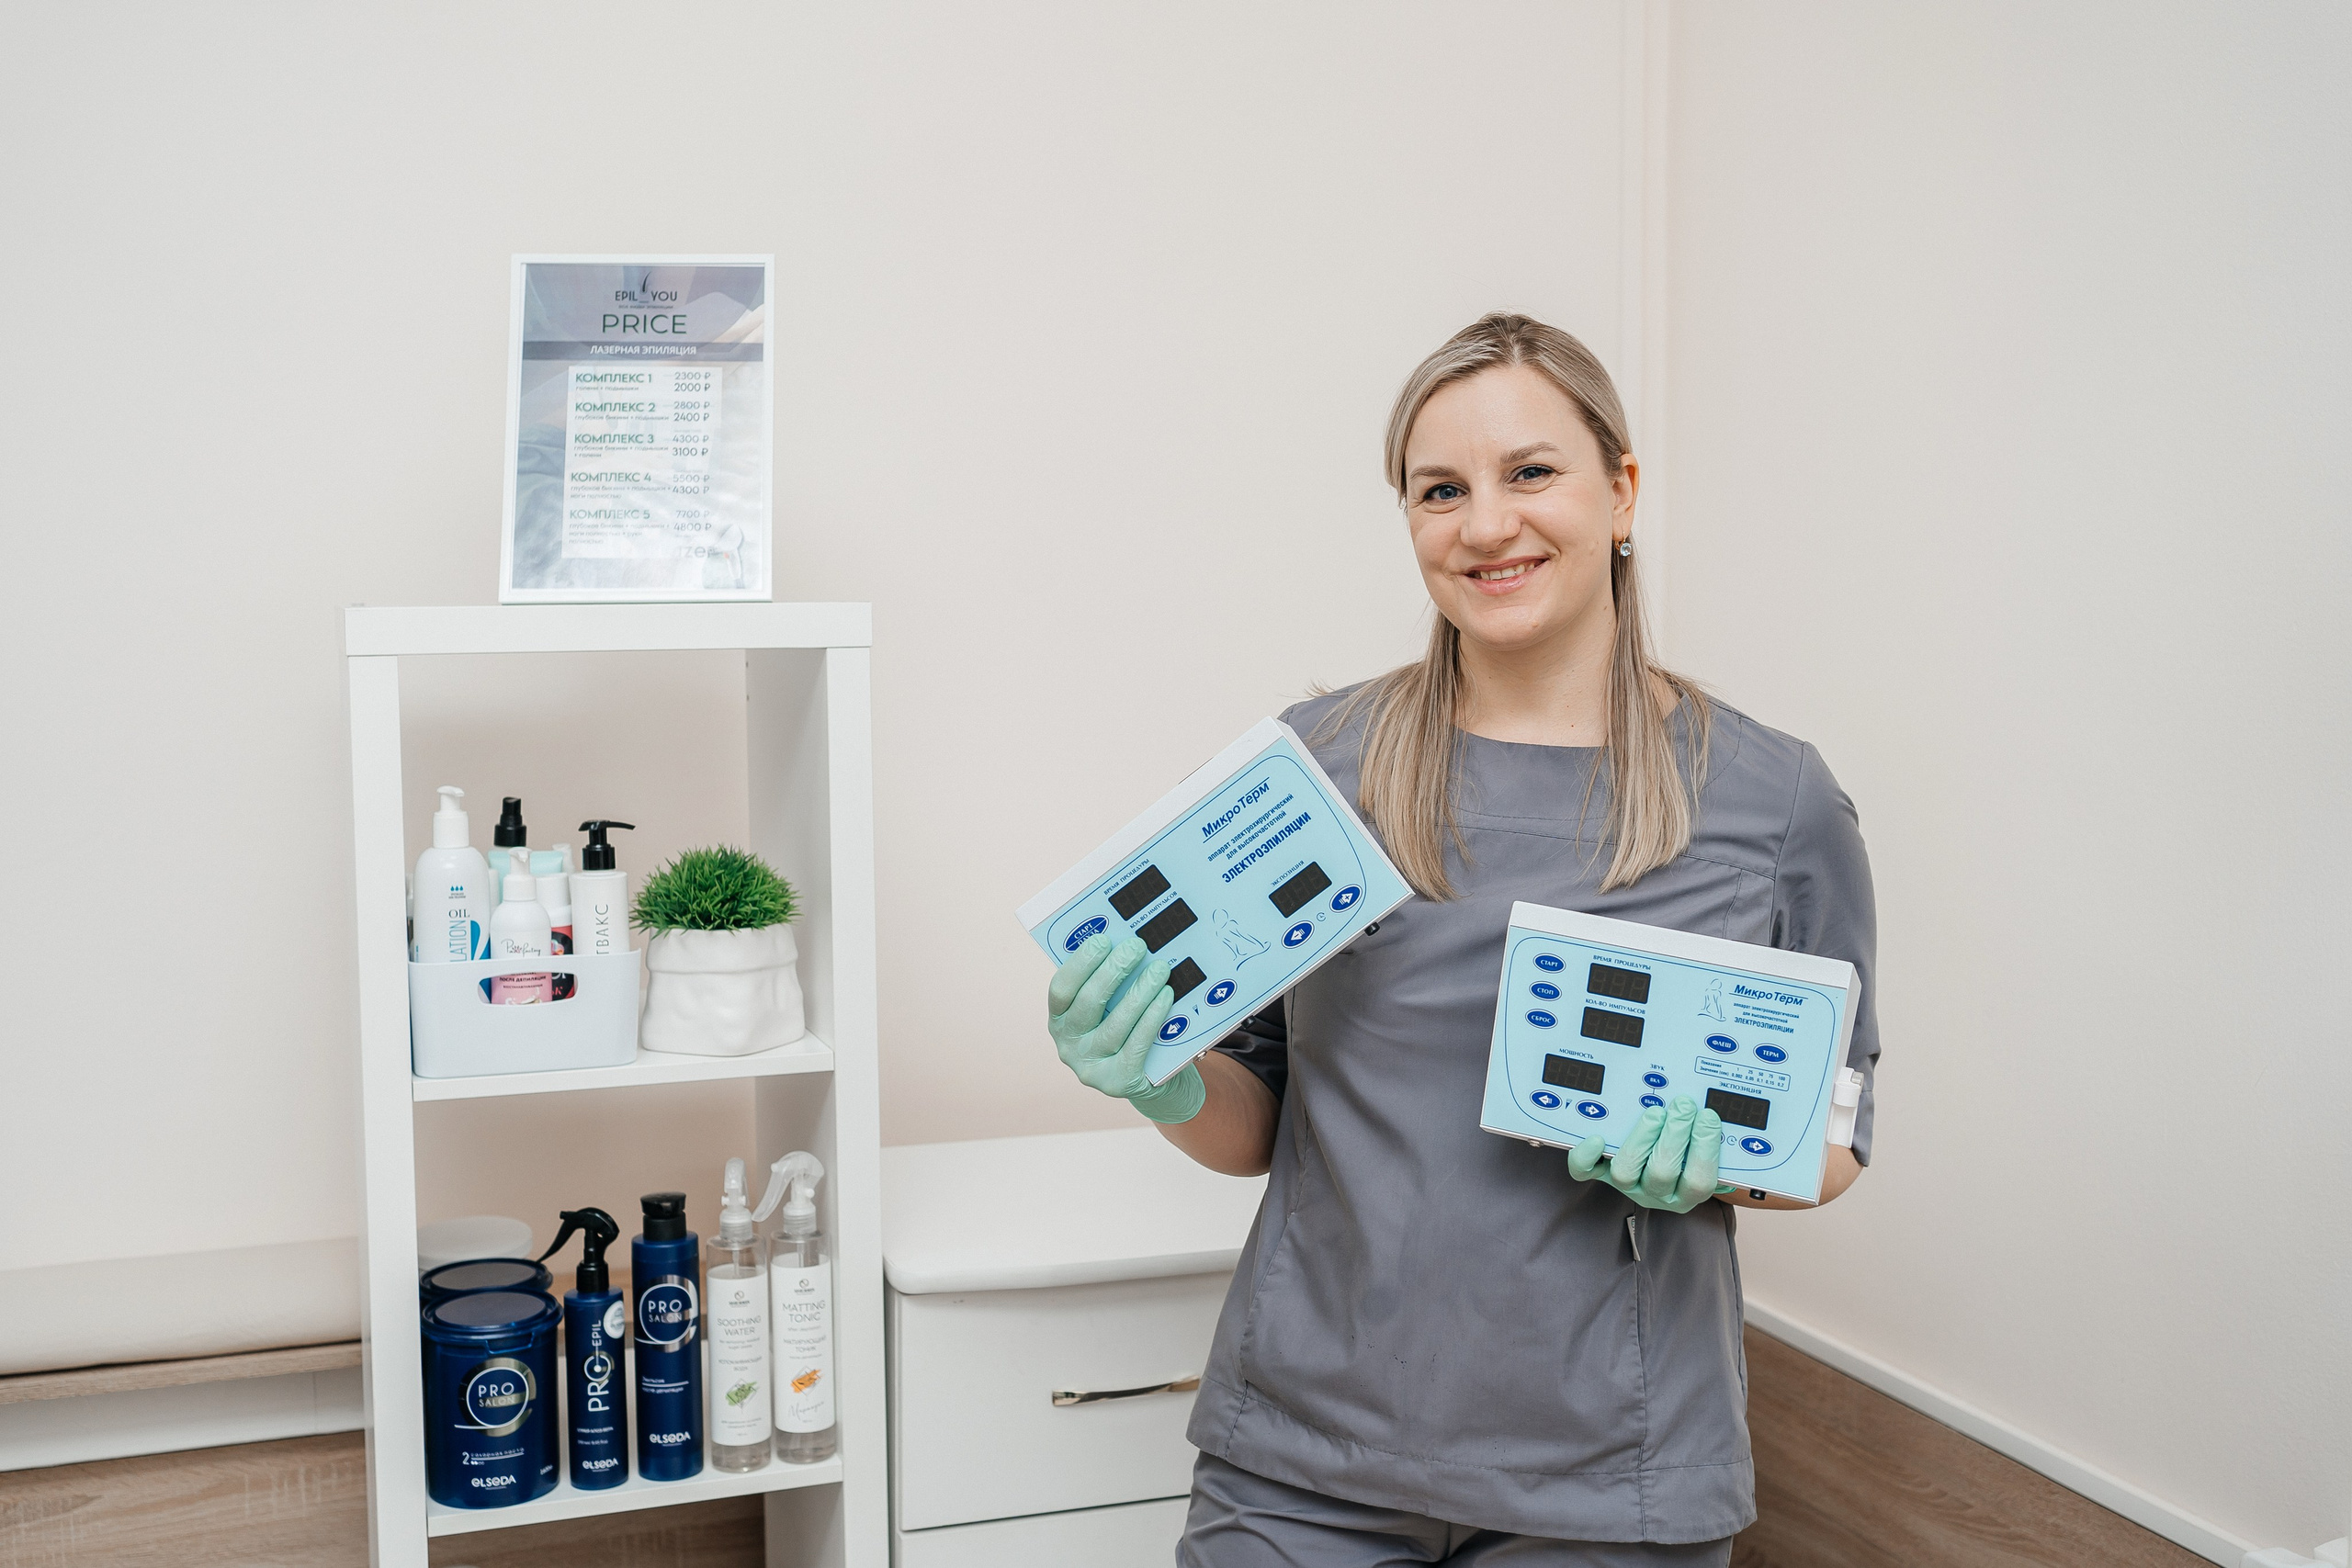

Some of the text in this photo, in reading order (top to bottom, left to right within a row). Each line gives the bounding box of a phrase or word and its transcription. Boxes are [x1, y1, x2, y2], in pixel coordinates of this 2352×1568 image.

[602, 313, 687, 334] PRICE
[590, 344, 696, 356] ЛАЗЕРНАЯ ЭПИЛЯЦИЯ
[575, 373, 652, 383] КОМПЛЕКС 1
[673, 371, 701, 380] 2300
[673, 382, 701, 392] 2000
[574, 402, 656, 412] КОМПЛЕКС 2
[673, 401, 700, 410] 2800
[673, 412, 700, 422] 2400
[574, 434, 654, 444] КОМПЛЕКС 3
[672, 434, 699, 444] 4300
[672, 446, 697, 457] 3100
[571, 472, 651, 482] КОМПЛЕКС 4
[673, 474, 700, 483] 5500
[672, 485, 699, 495] 4300
[570, 509, 650, 520] КОМПЛЕКС 5
[673, 522, 701, 532] 4800
[1200, 782, 1270, 838] МикроТерм
[1207, 793, 1294, 862] аппарат электрохирургический
[1226, 810, 1287, 860] для высокочастотной
[1221, 811, 1312, 884] ЭЛЕКТРОЭПИЛЯЦИИ
[1103, 858, 1150, 896] ВРЕМЯ ПРОЦЕДУРЫ
[1270, 860, 1305, 887] ЭКСПОЗИЦИЯ
[448, 908, 469, 919] OIL
[1129, 890, 1178, 930] КОЛ-ВО ИМПУЛЬСОВ
[1073, 922, 1093, 940] СТАРТ
[1540, 959, 1558, 967] СТАРТ
[1592, 954, 1651, 970] ВРЕМЯ ПРОЦЕДУРЫ
[1536, 987, 1555, 996] СТОП
[1734, 984, 1804, 1006] МикроТерм
[1585, 998, 1646, 1015] КОЛ-ВО ИМПУЛЬСОВ
[1733, 1002, 1800, 1019] аппарат электрохирургический
[1531, 1014, 1552, 1023] СБРОС
[1751, 1011, 1788, 1024] высокочастотной
[1734, 1016, 1794, 1034] ЭЛЕКТРОЭПИЛЯЦИИ
[1558, 1047, 1594, 1059] МОЩНОСТЬ
[1712, 1040, 1780, 1058] ФЛЕШ ТЕРМ
[1650, 1063, 1665, 1071] ЗВУК
[1719, 1081, 1762, 1095] ЭКСПОЗИЦИЯ
[648, 1299, 683, 1314] PRO
[782, 1300, 826, 1313] MATTING
[648, 1312, 683, 1324] SALON
[717, 1314, 762, 1327] SOOTHING
[788, 1312, 821, 1324] TONIC
[592, 1319, 602, 1347] EPIL
[724, 1326, 756, 1337] WATER
[478, 1382, 514, 1397] PRO
[478, 1396, 515, 1408] SALON
[462, 1451, 469, 1465] 2
